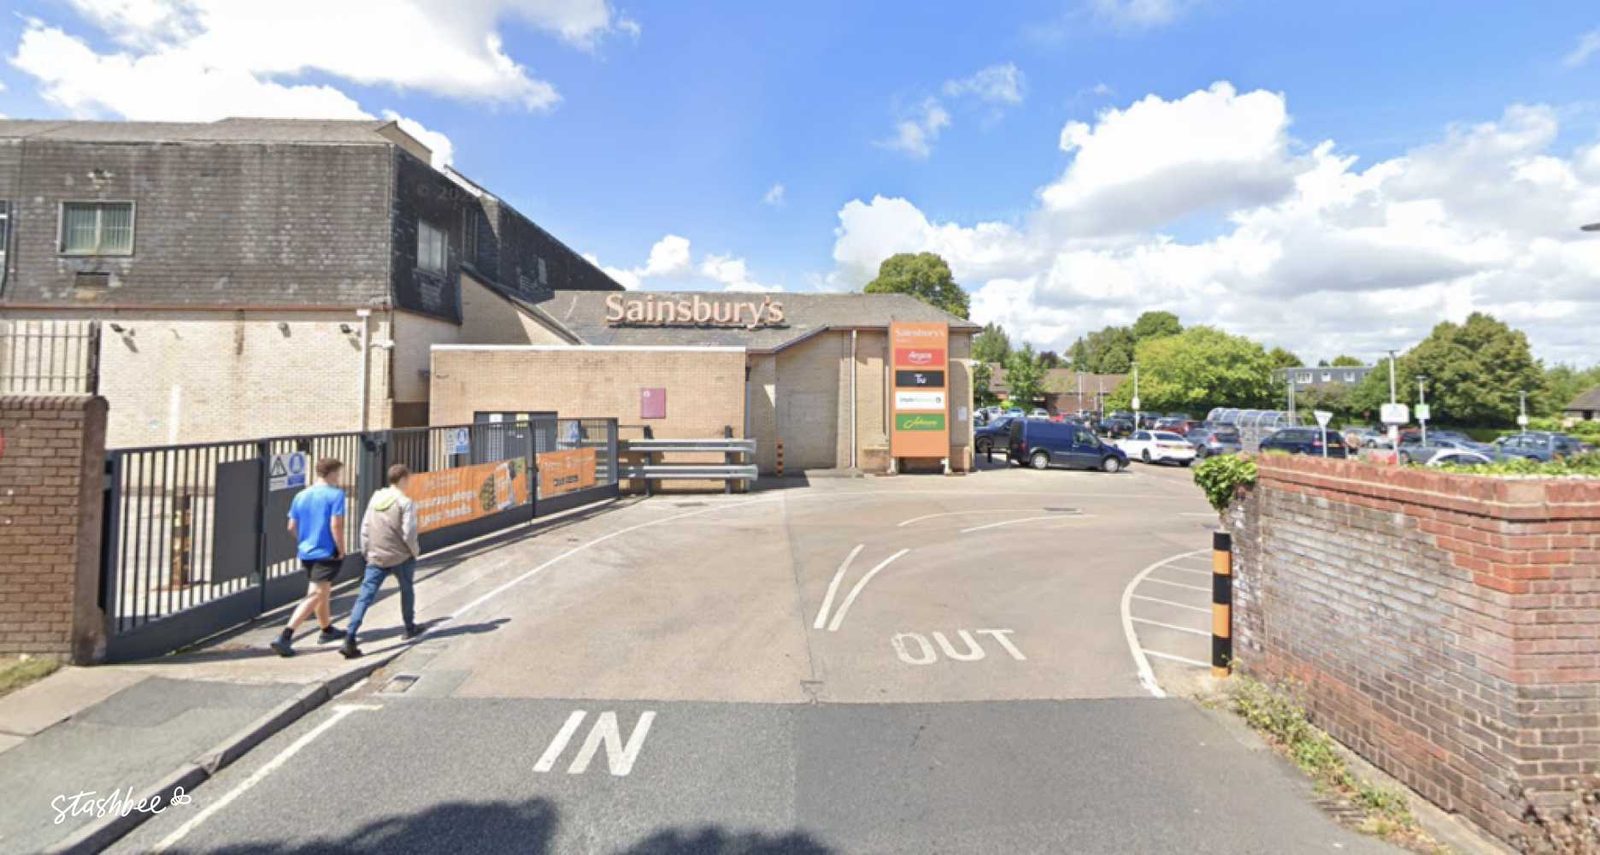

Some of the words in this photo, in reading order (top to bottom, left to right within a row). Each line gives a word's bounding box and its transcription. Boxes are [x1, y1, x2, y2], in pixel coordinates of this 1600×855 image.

[605, 292, 785, 329] Sainsbury's
[890, 628, 1027, 665] OUT
[532, 710, 657, 776] IN
